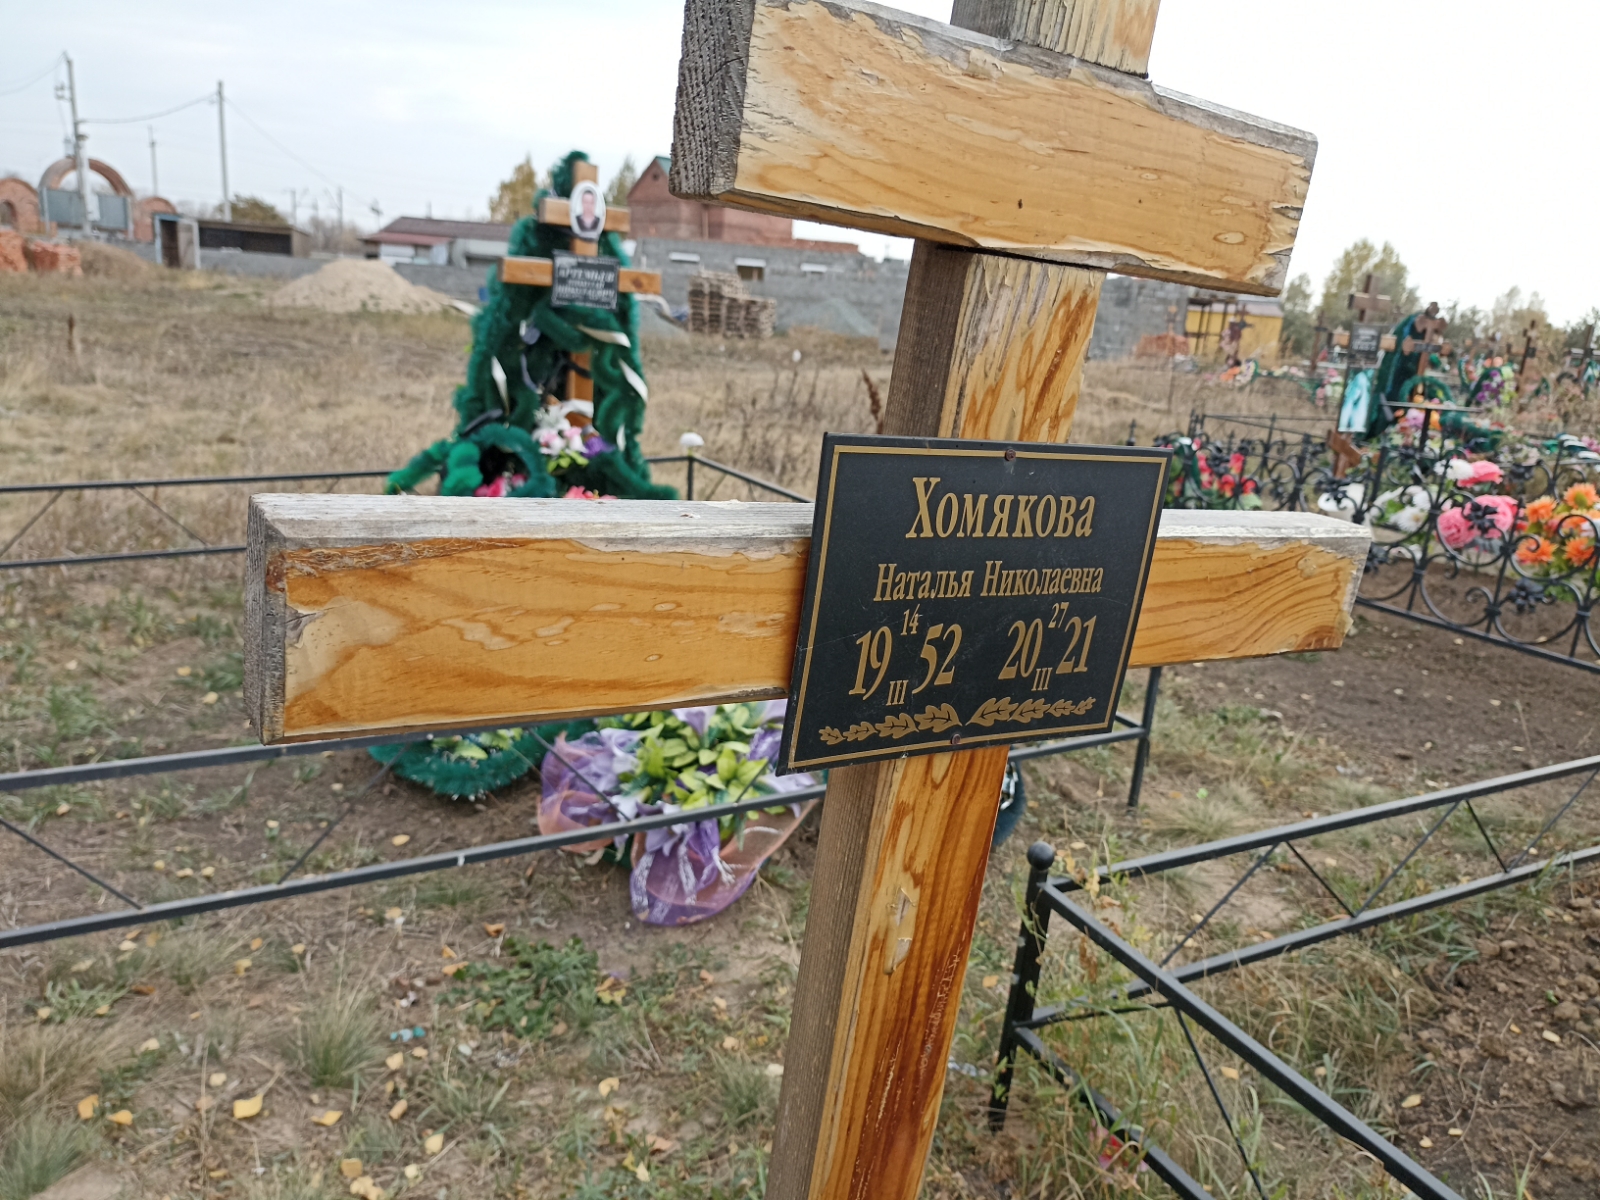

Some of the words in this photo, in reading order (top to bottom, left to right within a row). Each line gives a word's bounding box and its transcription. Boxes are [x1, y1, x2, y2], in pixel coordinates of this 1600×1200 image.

[905, 476, 1096, 539] Хомякова
[873, 563, 974, 602] Наталья
[980, 560, 1104, 597] Николаевна
[901, 603, 922, 636] 14
[1048, 601, 1070, 630] 27
[848, 625, 893, 701] 19
[912, 623, 963, 695] 52
[998, 618, 1043, 680] 20
[1055, 615, 1097, 674] 21
